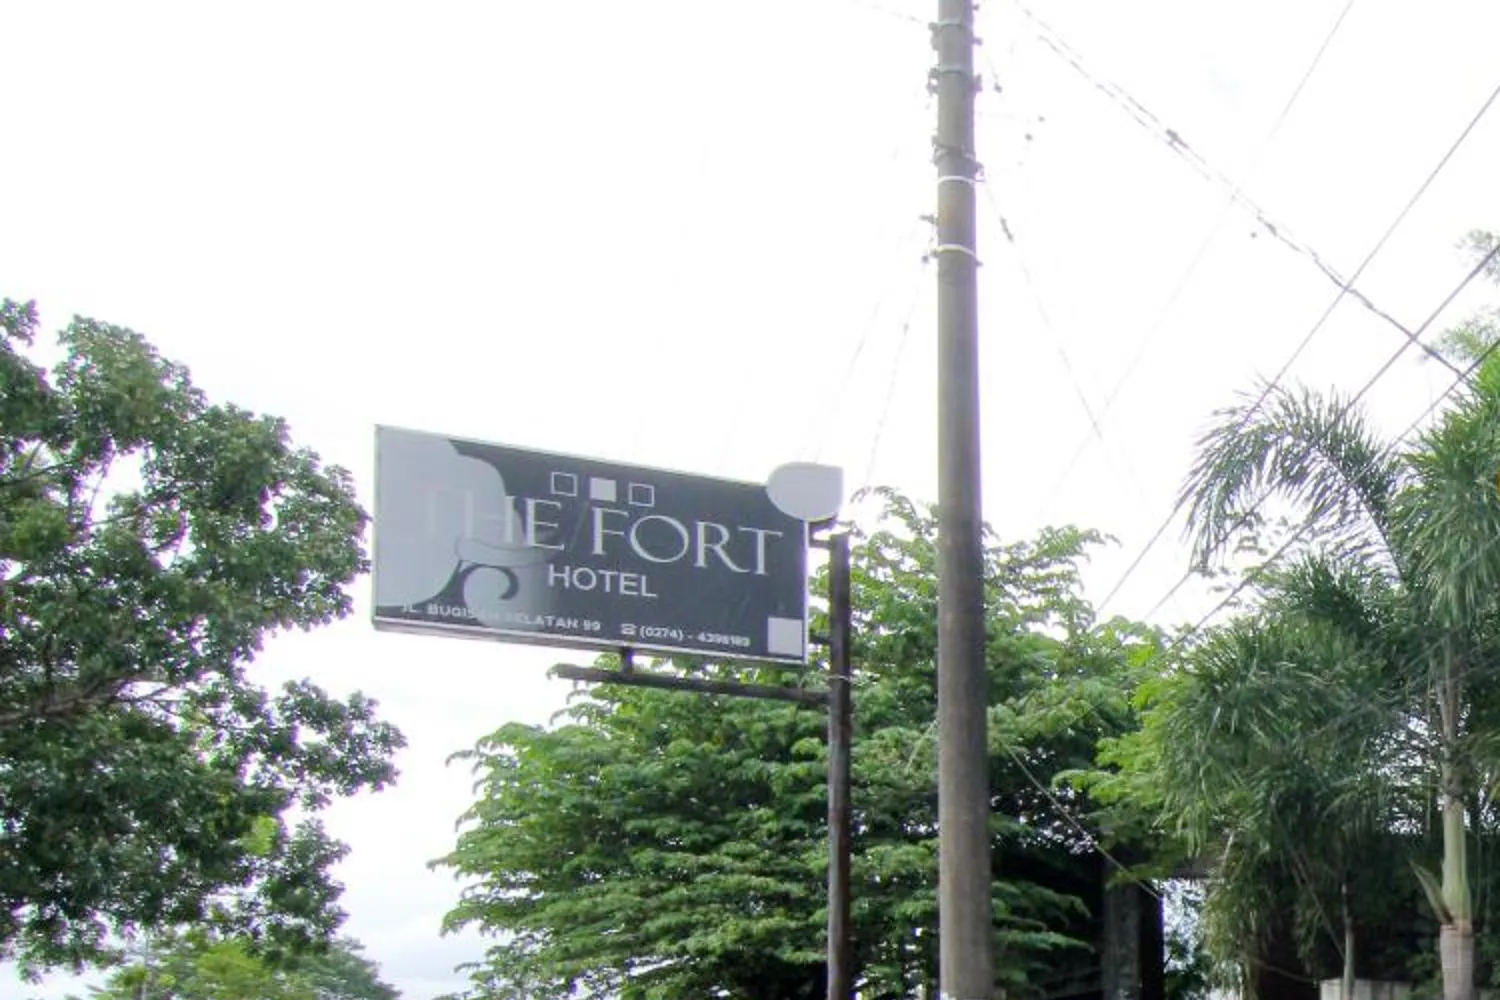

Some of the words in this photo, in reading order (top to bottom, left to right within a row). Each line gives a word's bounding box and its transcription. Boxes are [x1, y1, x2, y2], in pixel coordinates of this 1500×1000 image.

[591, 506, 784, 576] FORT
[548, 563, 658, 597] HOTEL
[640, 624, 683, 641] (0274)
